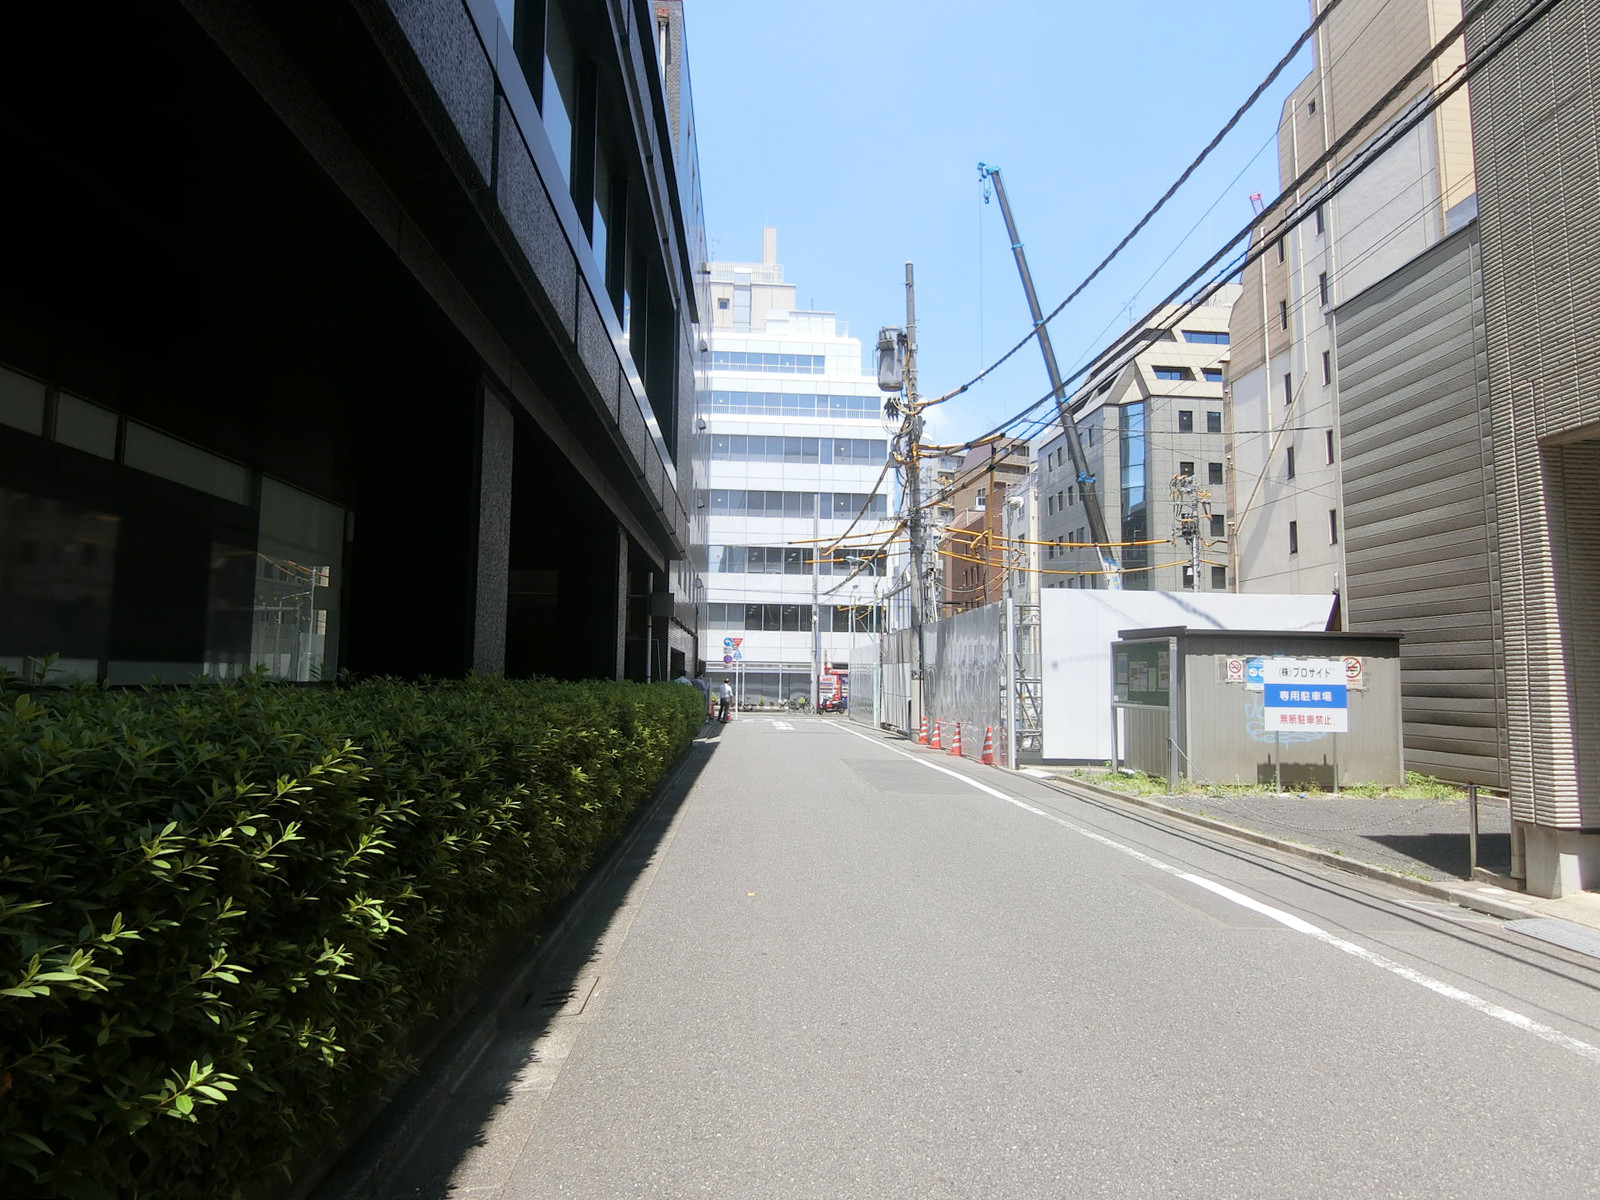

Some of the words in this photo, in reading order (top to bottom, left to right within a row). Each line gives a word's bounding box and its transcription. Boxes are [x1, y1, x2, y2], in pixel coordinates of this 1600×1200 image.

[1279, 690, 1332, 702] 専用駐車場
[1280, 714, 1332, 725] 無断駐車禁止
